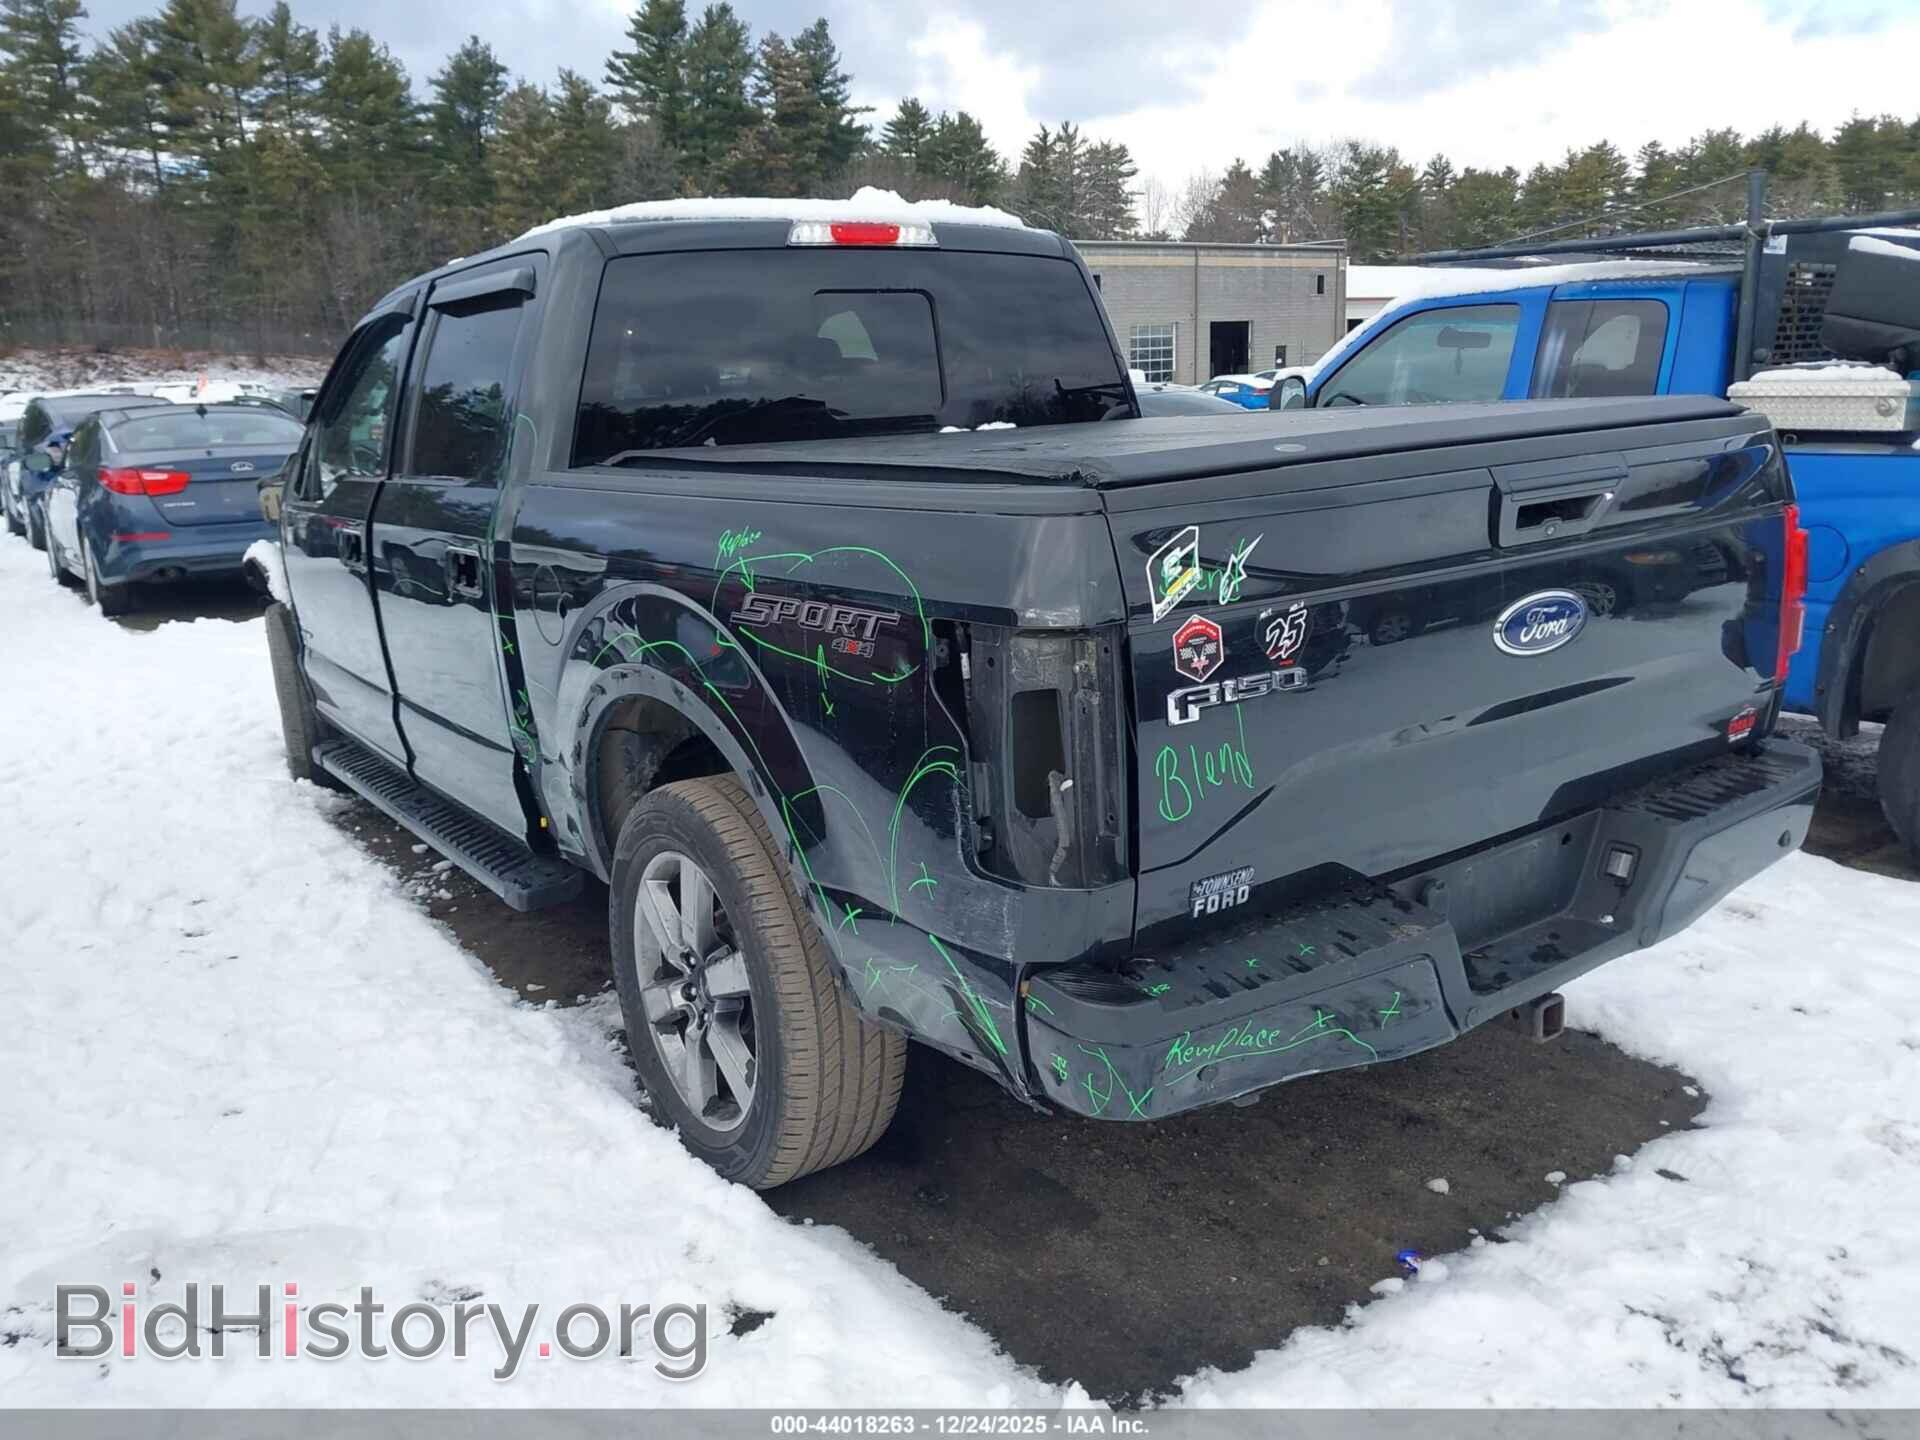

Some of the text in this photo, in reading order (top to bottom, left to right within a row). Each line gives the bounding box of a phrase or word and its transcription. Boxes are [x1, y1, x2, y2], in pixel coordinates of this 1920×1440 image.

[730, 592, 900, 641] SPORT
[1265, 609, 1307, 659] 25
[1520, 605, 1570, 642] Ford
[1156, 703, 1254, 821] Blend
[1193, 885, 1250, 918] FORD
[1200, 867, 1255, 896] TOWNSEND
